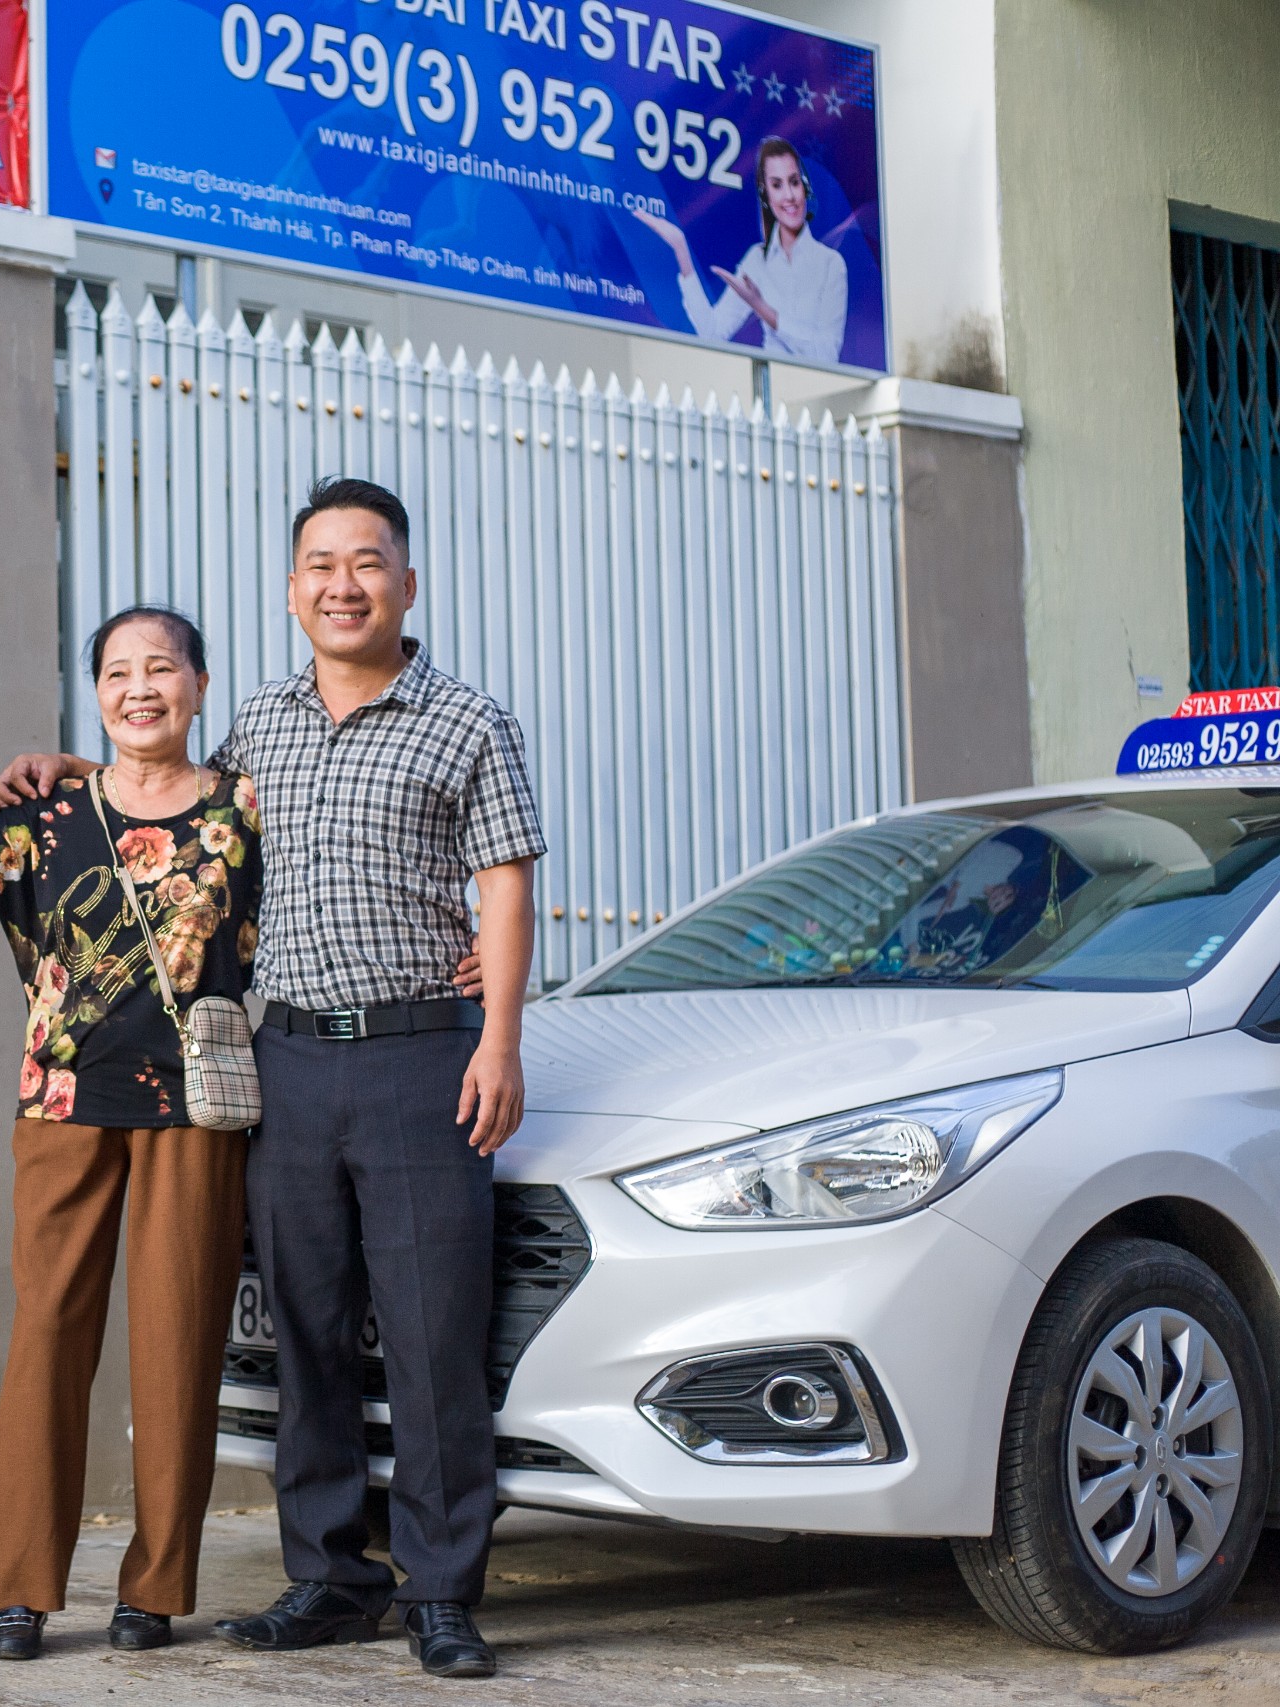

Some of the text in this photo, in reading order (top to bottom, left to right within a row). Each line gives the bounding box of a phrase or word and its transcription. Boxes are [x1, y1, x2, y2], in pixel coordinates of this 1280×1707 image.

[484, 0, 566, 51] TAXI
[579, 0, 725, 90] STAR
[221, 3, 743, 190] 0259(3) 952 952
[131, 158, 412, 229] taxistar@taxigiadinhninhthuan.com
[318, 126, 667, 218] www.taxigiadinhninhthuan.com
[132, 188, 167, 212] Tân
[229, 206, 282, 235] Thành
[321, 224, 348, 249] Tp.
[350, 230, 393, 255] Phan
[395, 238, 480, 275] Rang-Tháp
[563, 271, 598, 296] Ninh
[599, 277, 646, 306] Thuận
[1137, 741, 1195, 770] 02593
[1199, 720, 1260, 766] 952
[1180, 690, 1280, 718] STAR TAXI
